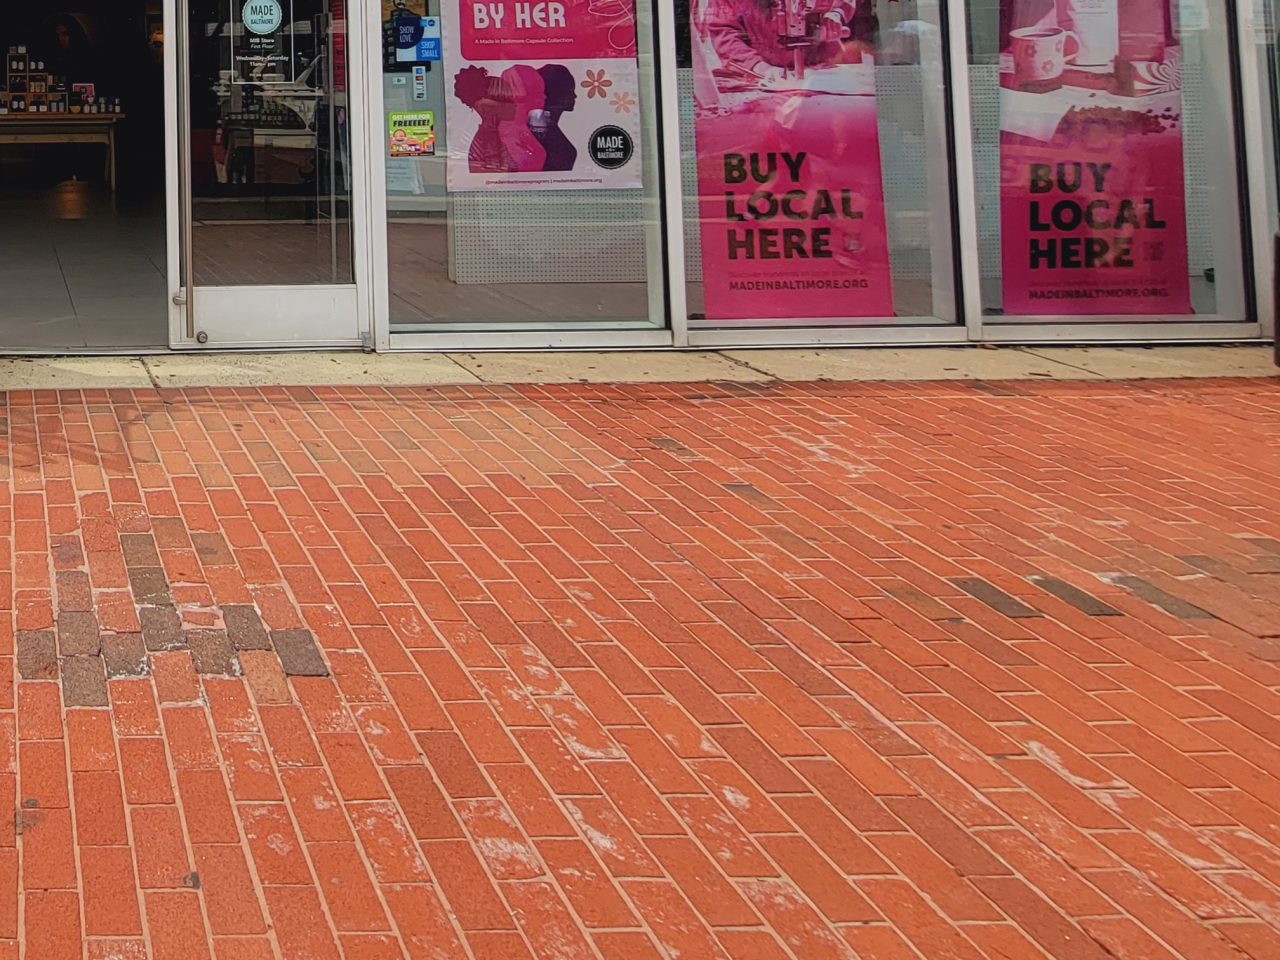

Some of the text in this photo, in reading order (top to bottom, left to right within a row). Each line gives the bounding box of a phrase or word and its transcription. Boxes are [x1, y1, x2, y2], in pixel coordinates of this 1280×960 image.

[250, 5, 274, 16] MADE
[473, 2, 566, 29] BY HER
[399, 26, 415, 34] SHOW
[421, 41, 435, 49] SHOP
[421, 49, 439, 58] SMALL
[597, 136, 624, 148] MADE
[724, 151, 807, 184] BUY
[1029, 162, 1112, 194] BUY
[725, 189, 865, 221] LOCAL
[1029, 198, 1166, 232] LOCAL
[728, 227, 833, 260] HERE
[1029, 237, 1134, 269] HERE
[729, 279, 869, 291] MADEINBALTIMORE.ORG
[1029, 288, 1169, 300] MADEINBALTIMORE.ORG
